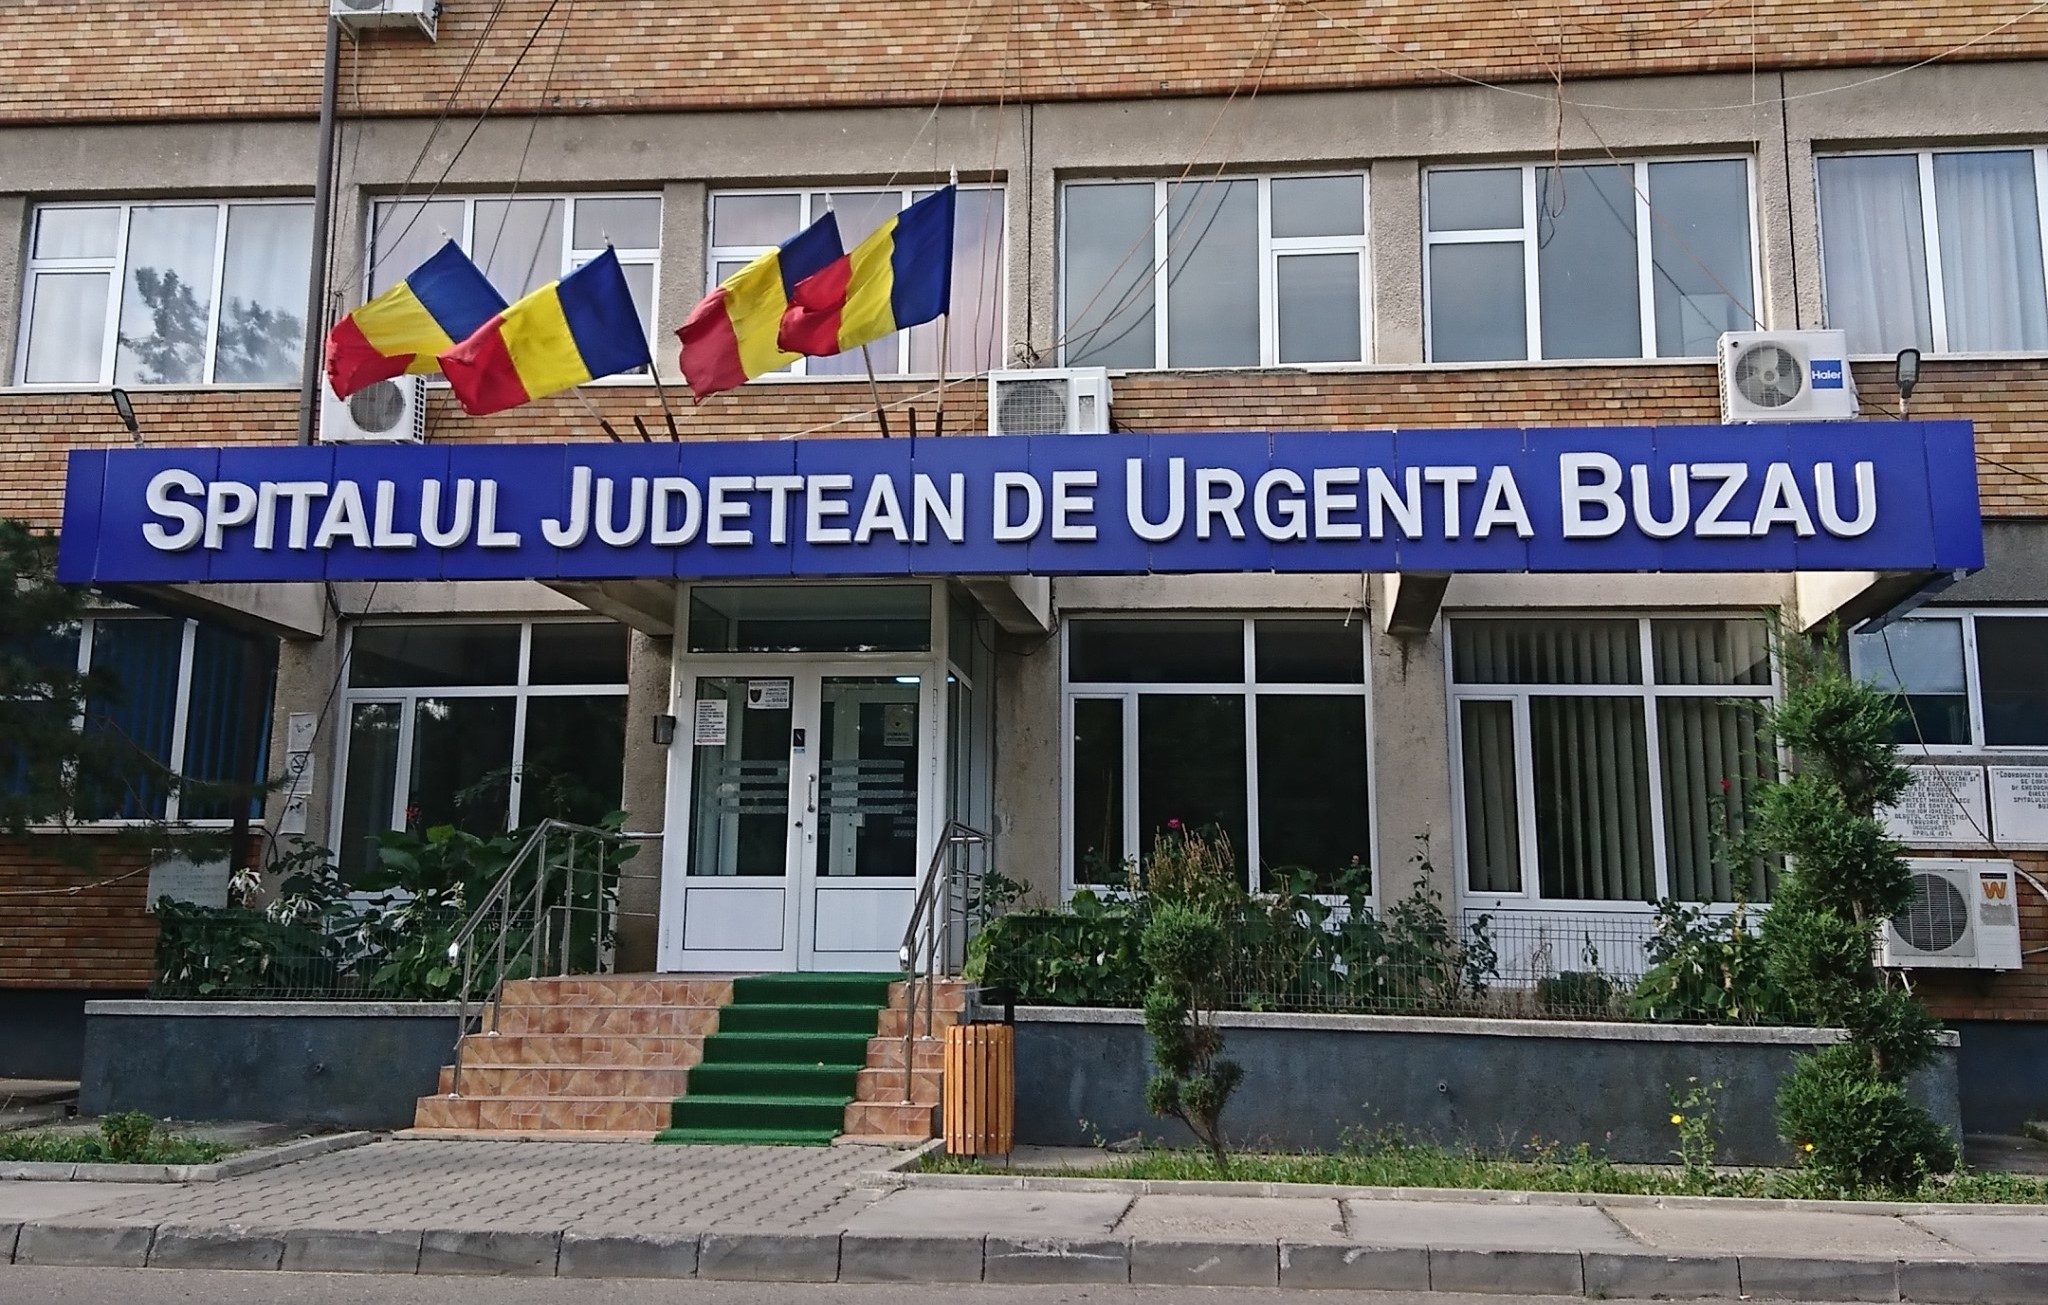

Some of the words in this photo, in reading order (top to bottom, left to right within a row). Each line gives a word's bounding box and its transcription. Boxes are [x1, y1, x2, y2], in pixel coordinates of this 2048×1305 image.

[1812, 369, 1842, 380] Haier
[143, 468, 521, 551] SPITALUL
[542, 466, 965, 547] JUDETEAN
[993, 470, 1097, 541] DE
[1126, 457, 1535, 541] URGENTA
[1559, 453, 1877, 539] BUZAU
